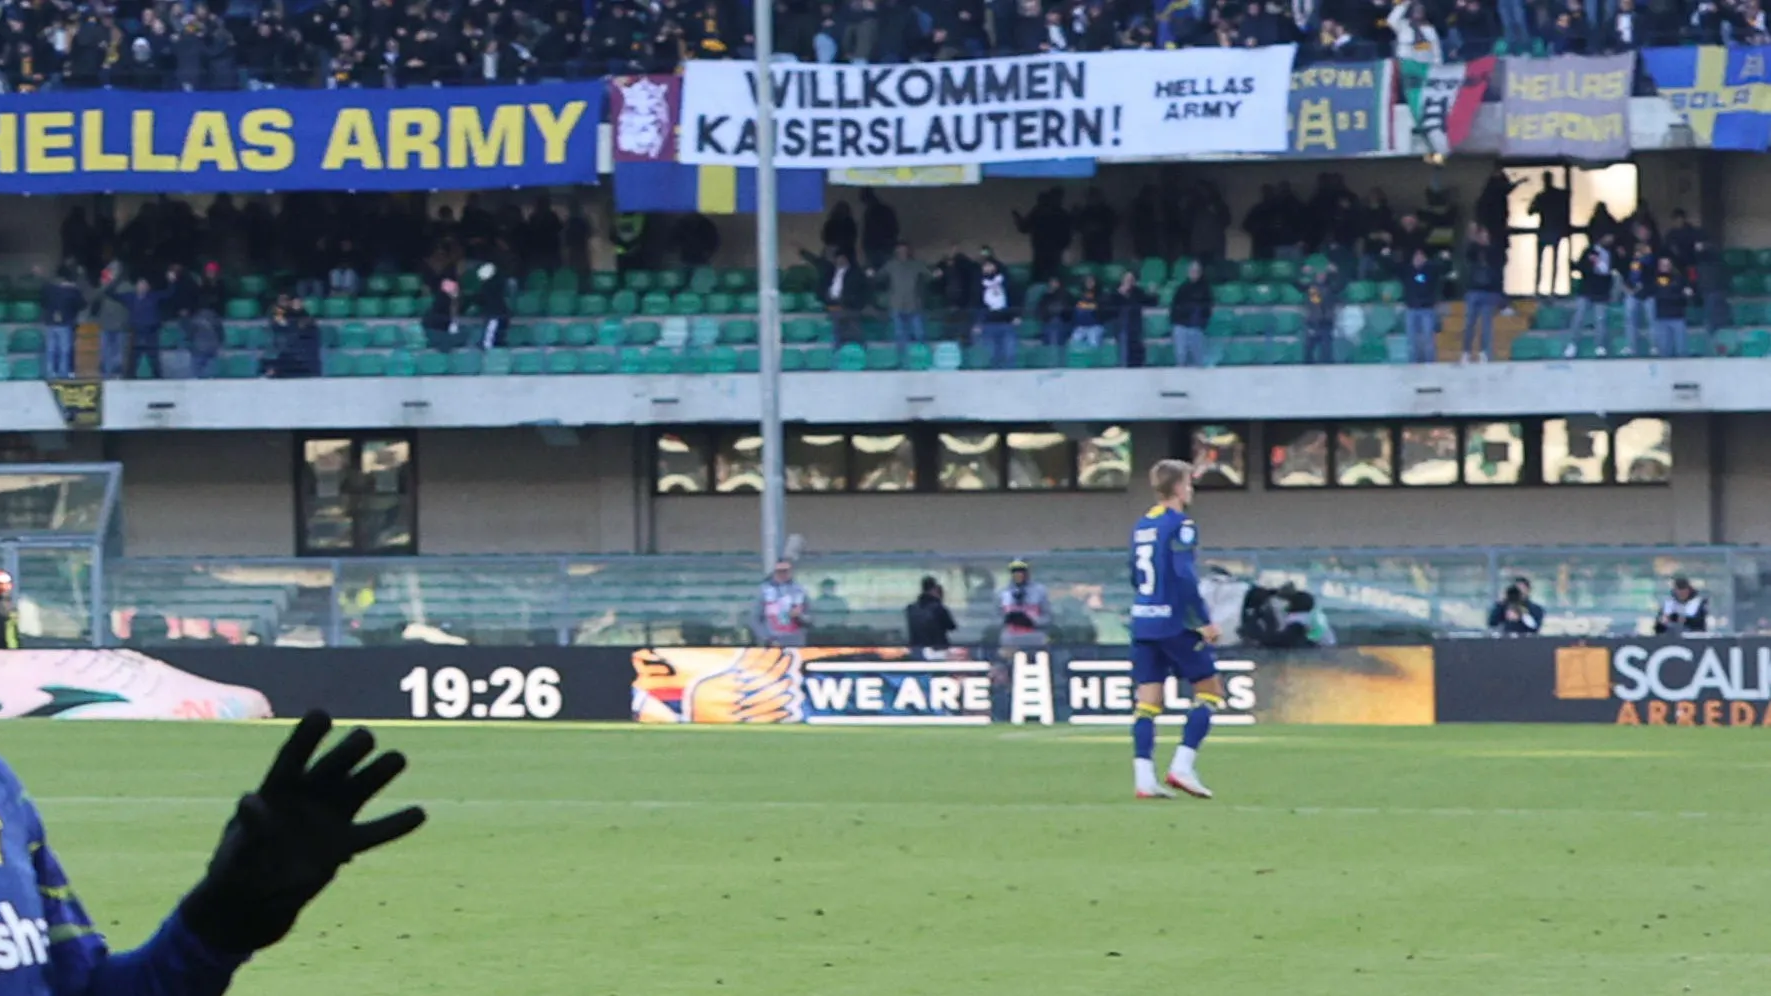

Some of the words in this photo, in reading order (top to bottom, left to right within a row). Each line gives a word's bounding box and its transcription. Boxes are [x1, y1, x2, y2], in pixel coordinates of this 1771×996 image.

[744, 60, 1087, 109] WILLKOMMEN
[1154, 76, 1255, 98] HELLAS
[1163, 99, 1243, 121] ARMY
[321, 101, 588, 171] ARMY
[399, 665, 563, 719] 19:26
[805, 676, 884, 710] WE
[892, 676, 992, 710] ARE
[1068, 675, 1257, 710] HELS
[1612, 645, 1771, 702] SCALI
